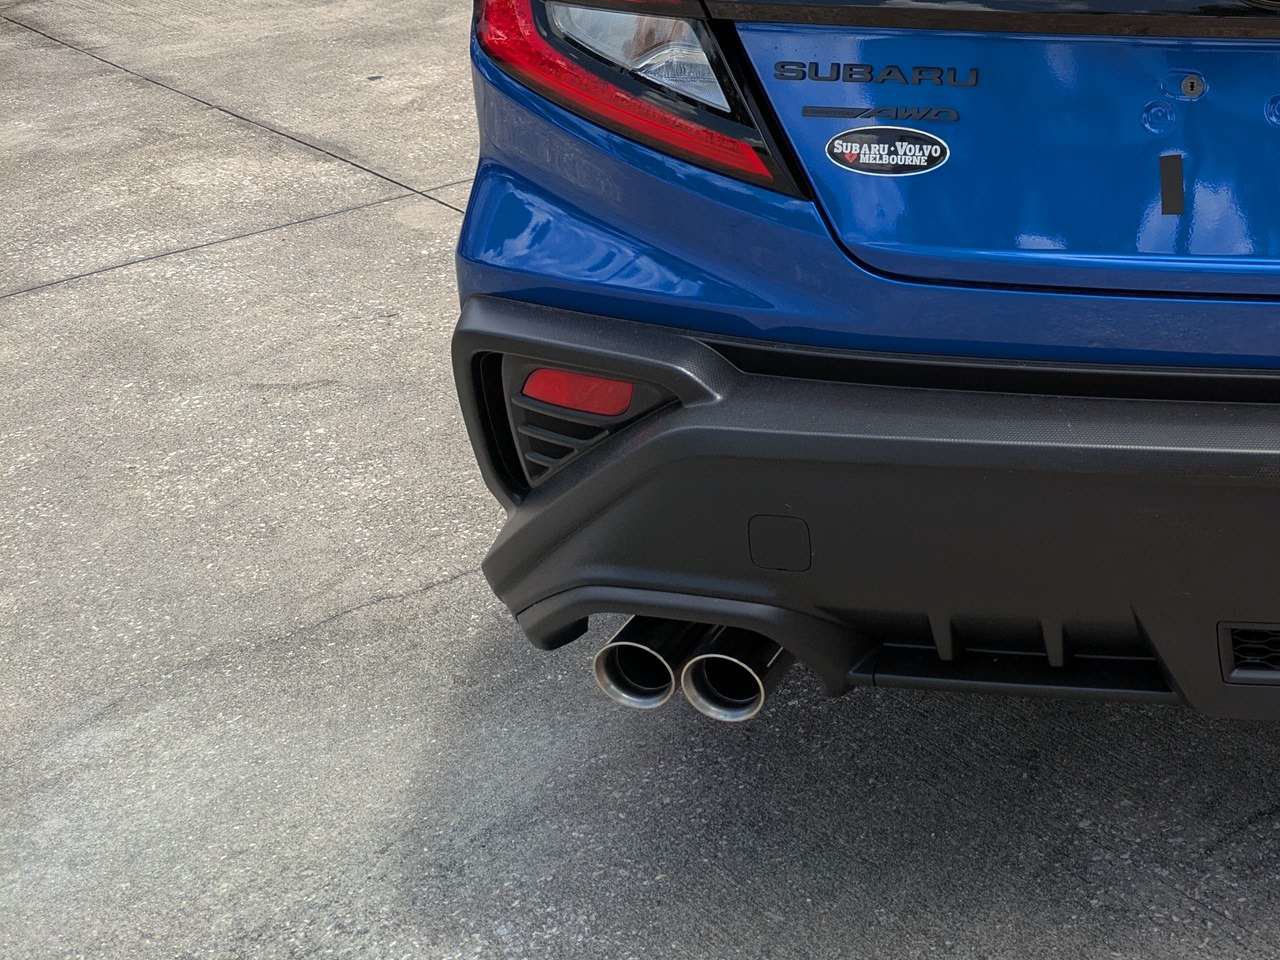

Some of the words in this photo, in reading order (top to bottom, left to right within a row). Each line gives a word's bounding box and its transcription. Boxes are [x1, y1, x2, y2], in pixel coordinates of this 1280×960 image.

[774, 61, 979, 87] SUBARU
[858, 105, 960, 122] AWD
[859, 154, 928, 166] MELBOURNE
